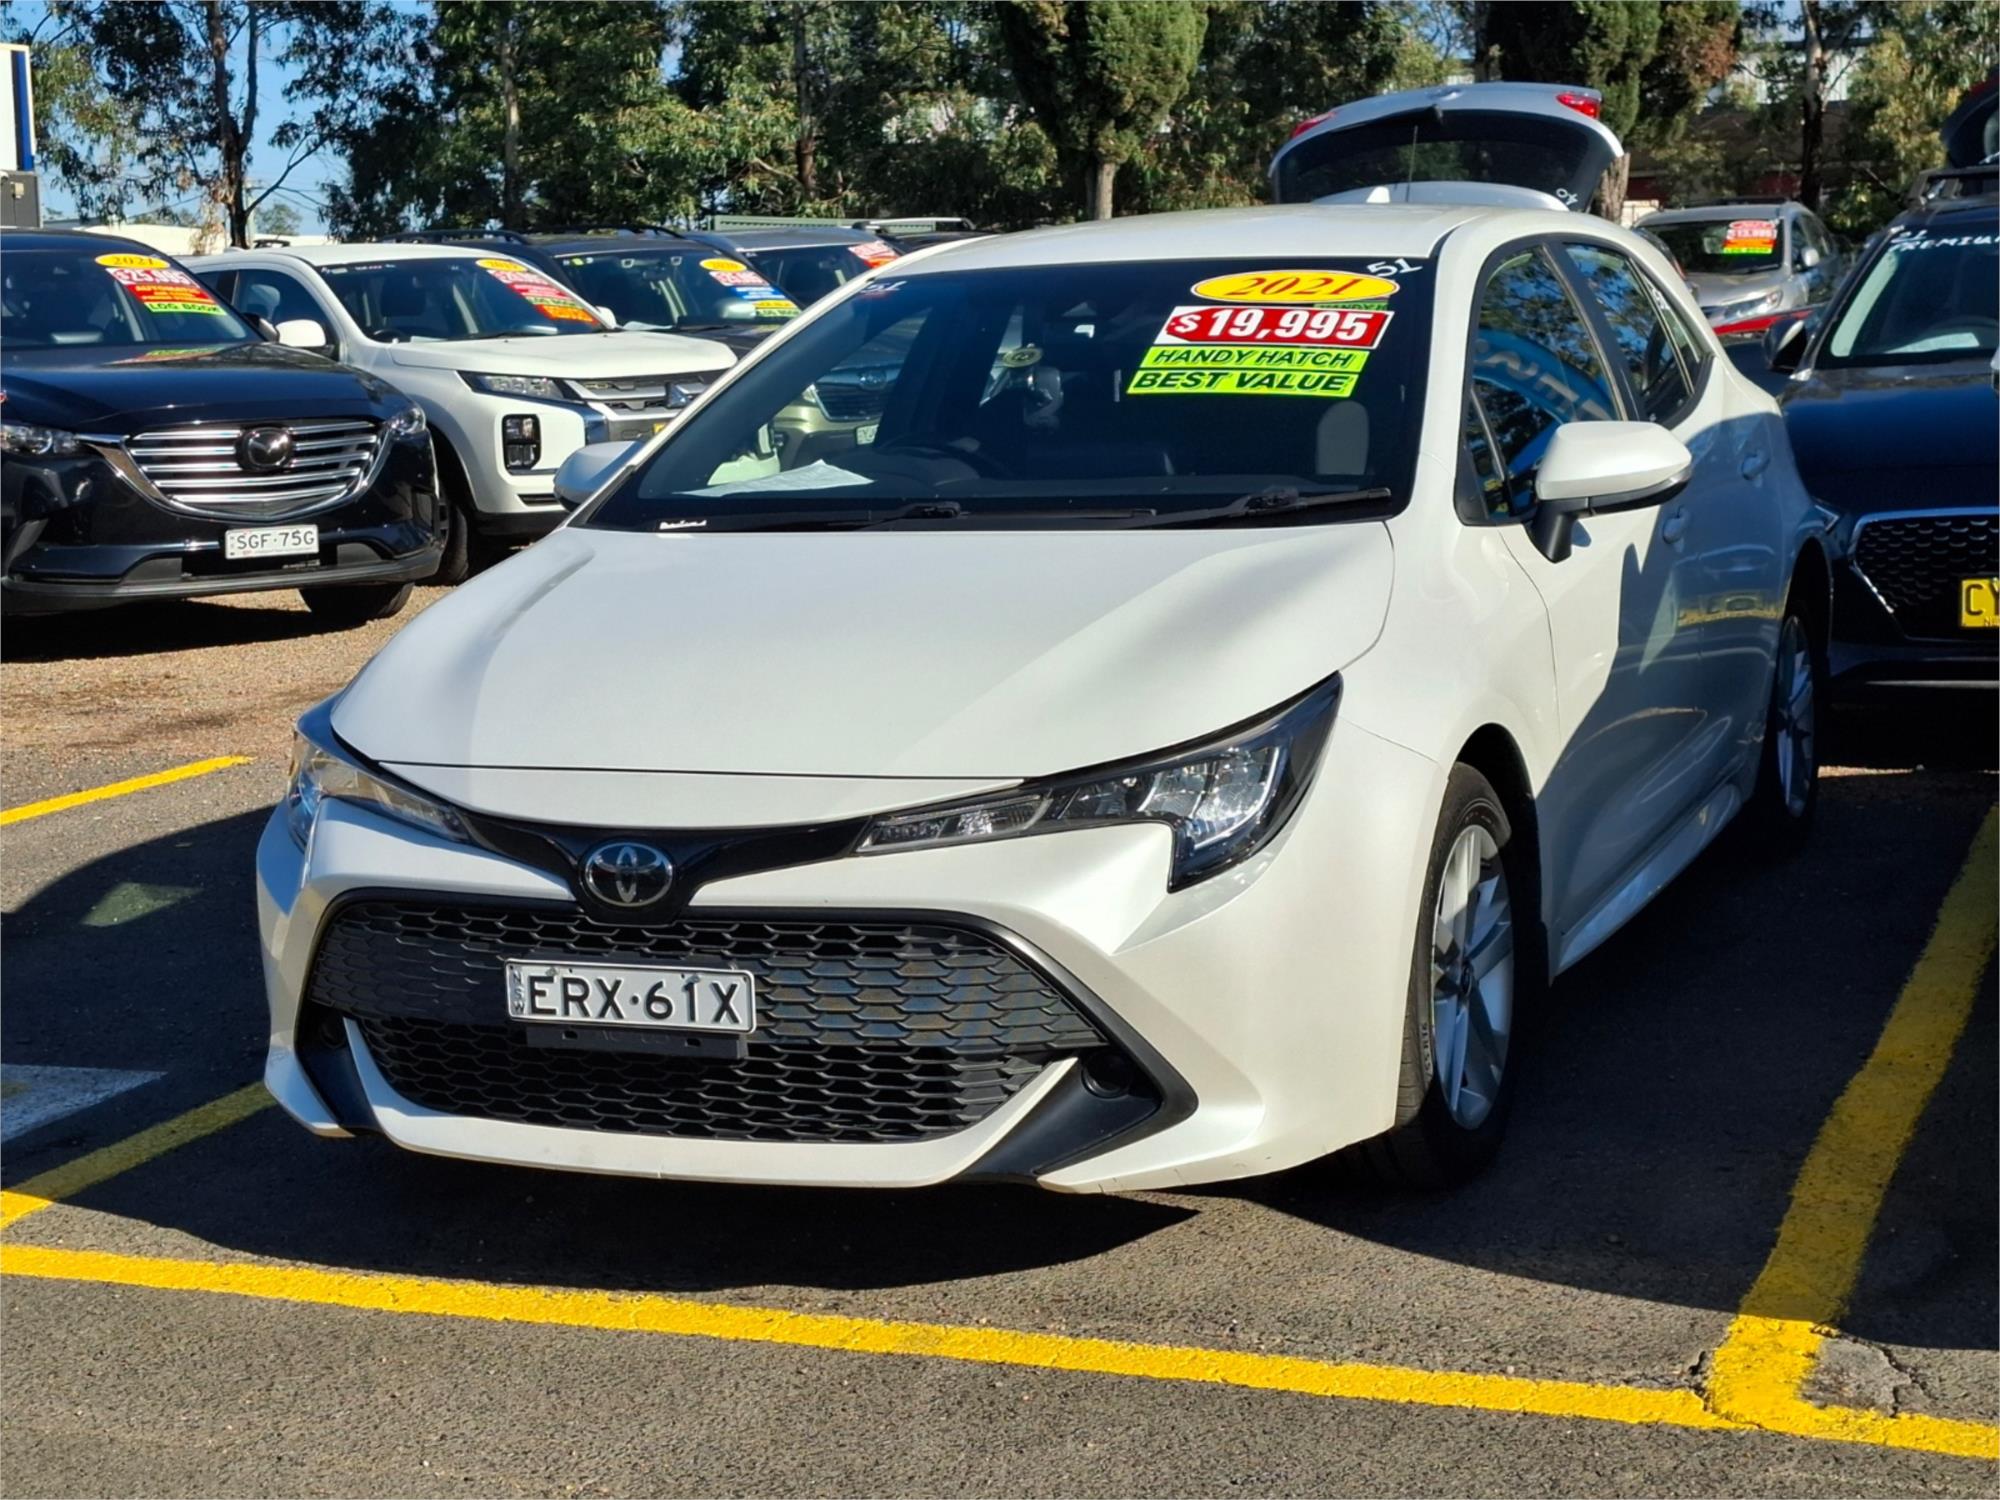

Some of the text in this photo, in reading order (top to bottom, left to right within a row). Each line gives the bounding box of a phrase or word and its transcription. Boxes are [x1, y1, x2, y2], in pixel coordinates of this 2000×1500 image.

[1367, 258, 1423, 277] 51
[1224, 277, 1364, 296] 2021
[1153, 349, 1354, 367] HANDY HATCH
[1133, 371, 1351, 391] BEST VALUE
